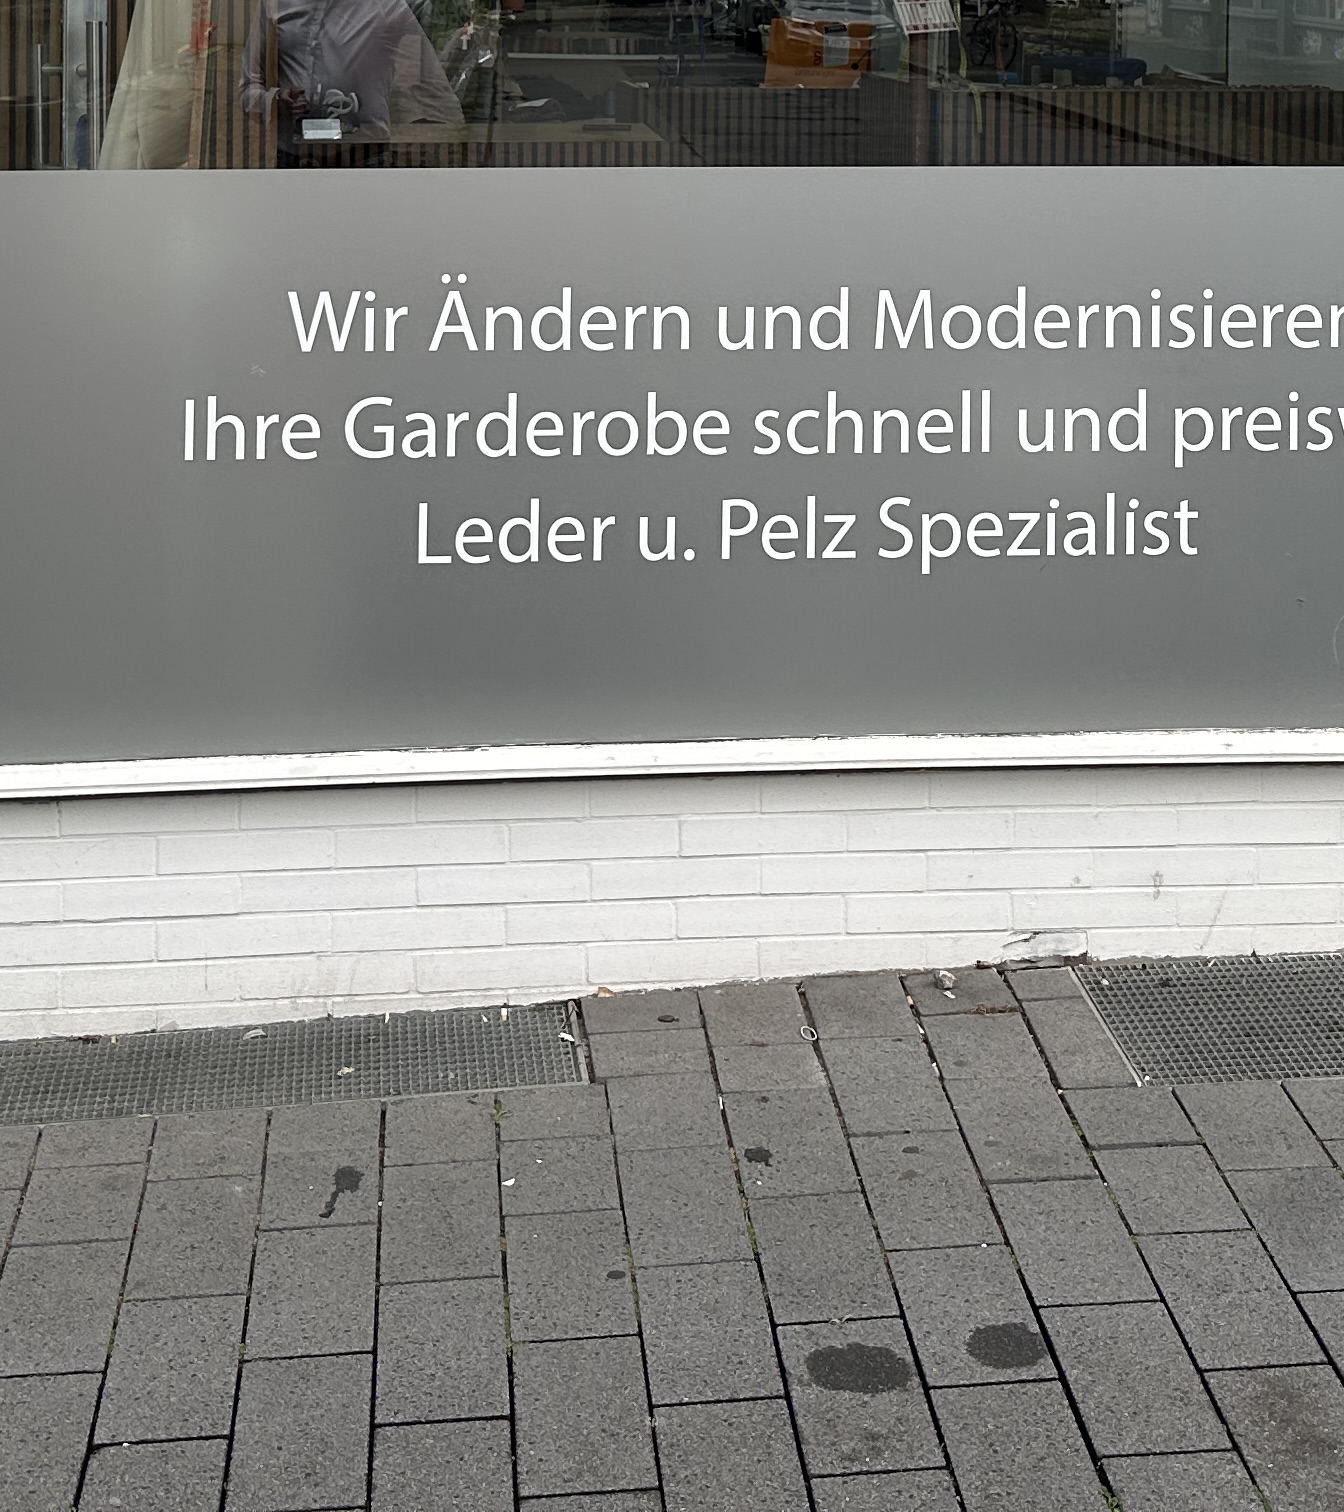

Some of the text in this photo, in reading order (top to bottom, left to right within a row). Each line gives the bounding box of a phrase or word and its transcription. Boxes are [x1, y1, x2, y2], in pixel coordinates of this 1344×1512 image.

[287, 290, 408, 352] Wir
[428, 273, 690, 352] Ändern
[717, 286, 850, 350] und
[183, 395, 321, 461] Ihre
[344, 391, 730, 460] Garderobe
[753, 389, 991, 455] schnell
[1017, 388, 1147, 453] und
[417, 492, 1199, 575] Leder u. Pelz Spezialist
